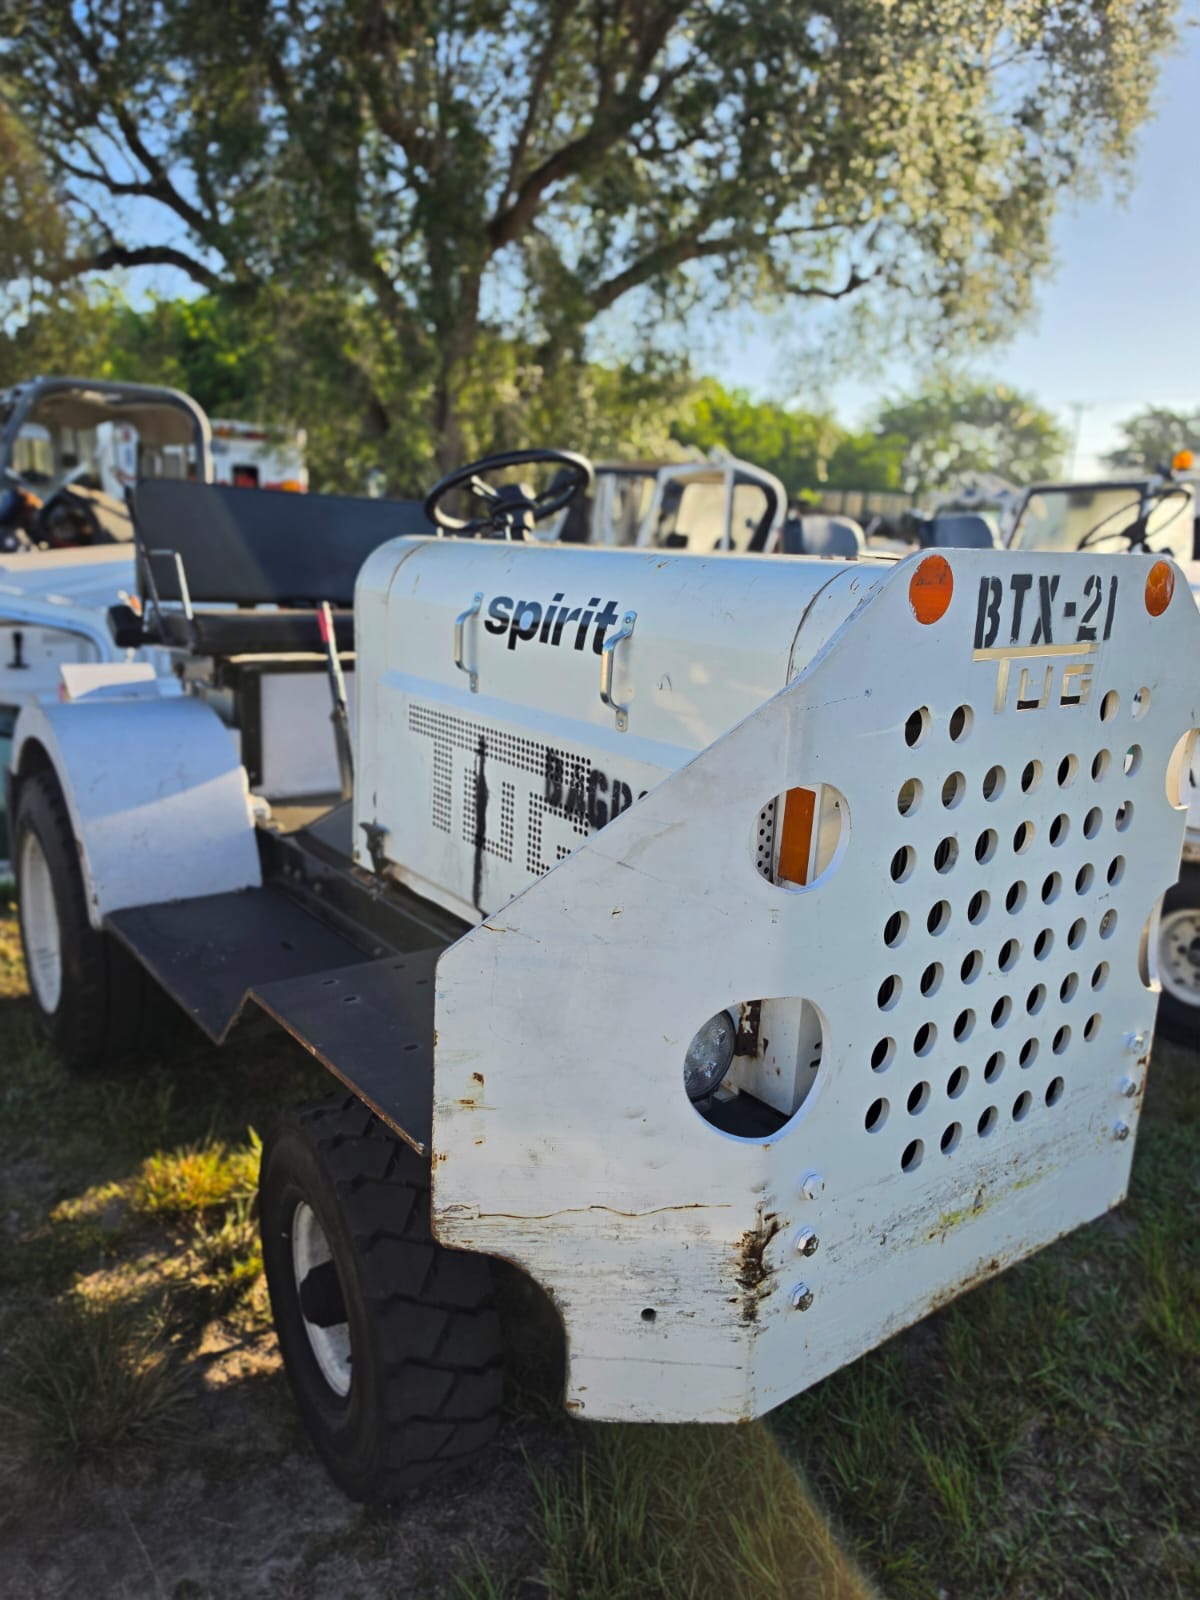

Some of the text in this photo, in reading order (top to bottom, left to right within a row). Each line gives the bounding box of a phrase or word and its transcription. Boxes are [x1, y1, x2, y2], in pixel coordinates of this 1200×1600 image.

[484, 593, 618, 655] spirit
[974, 574, 1118, 649] BTX-21
[973, 643, 1100, 715] TUG
